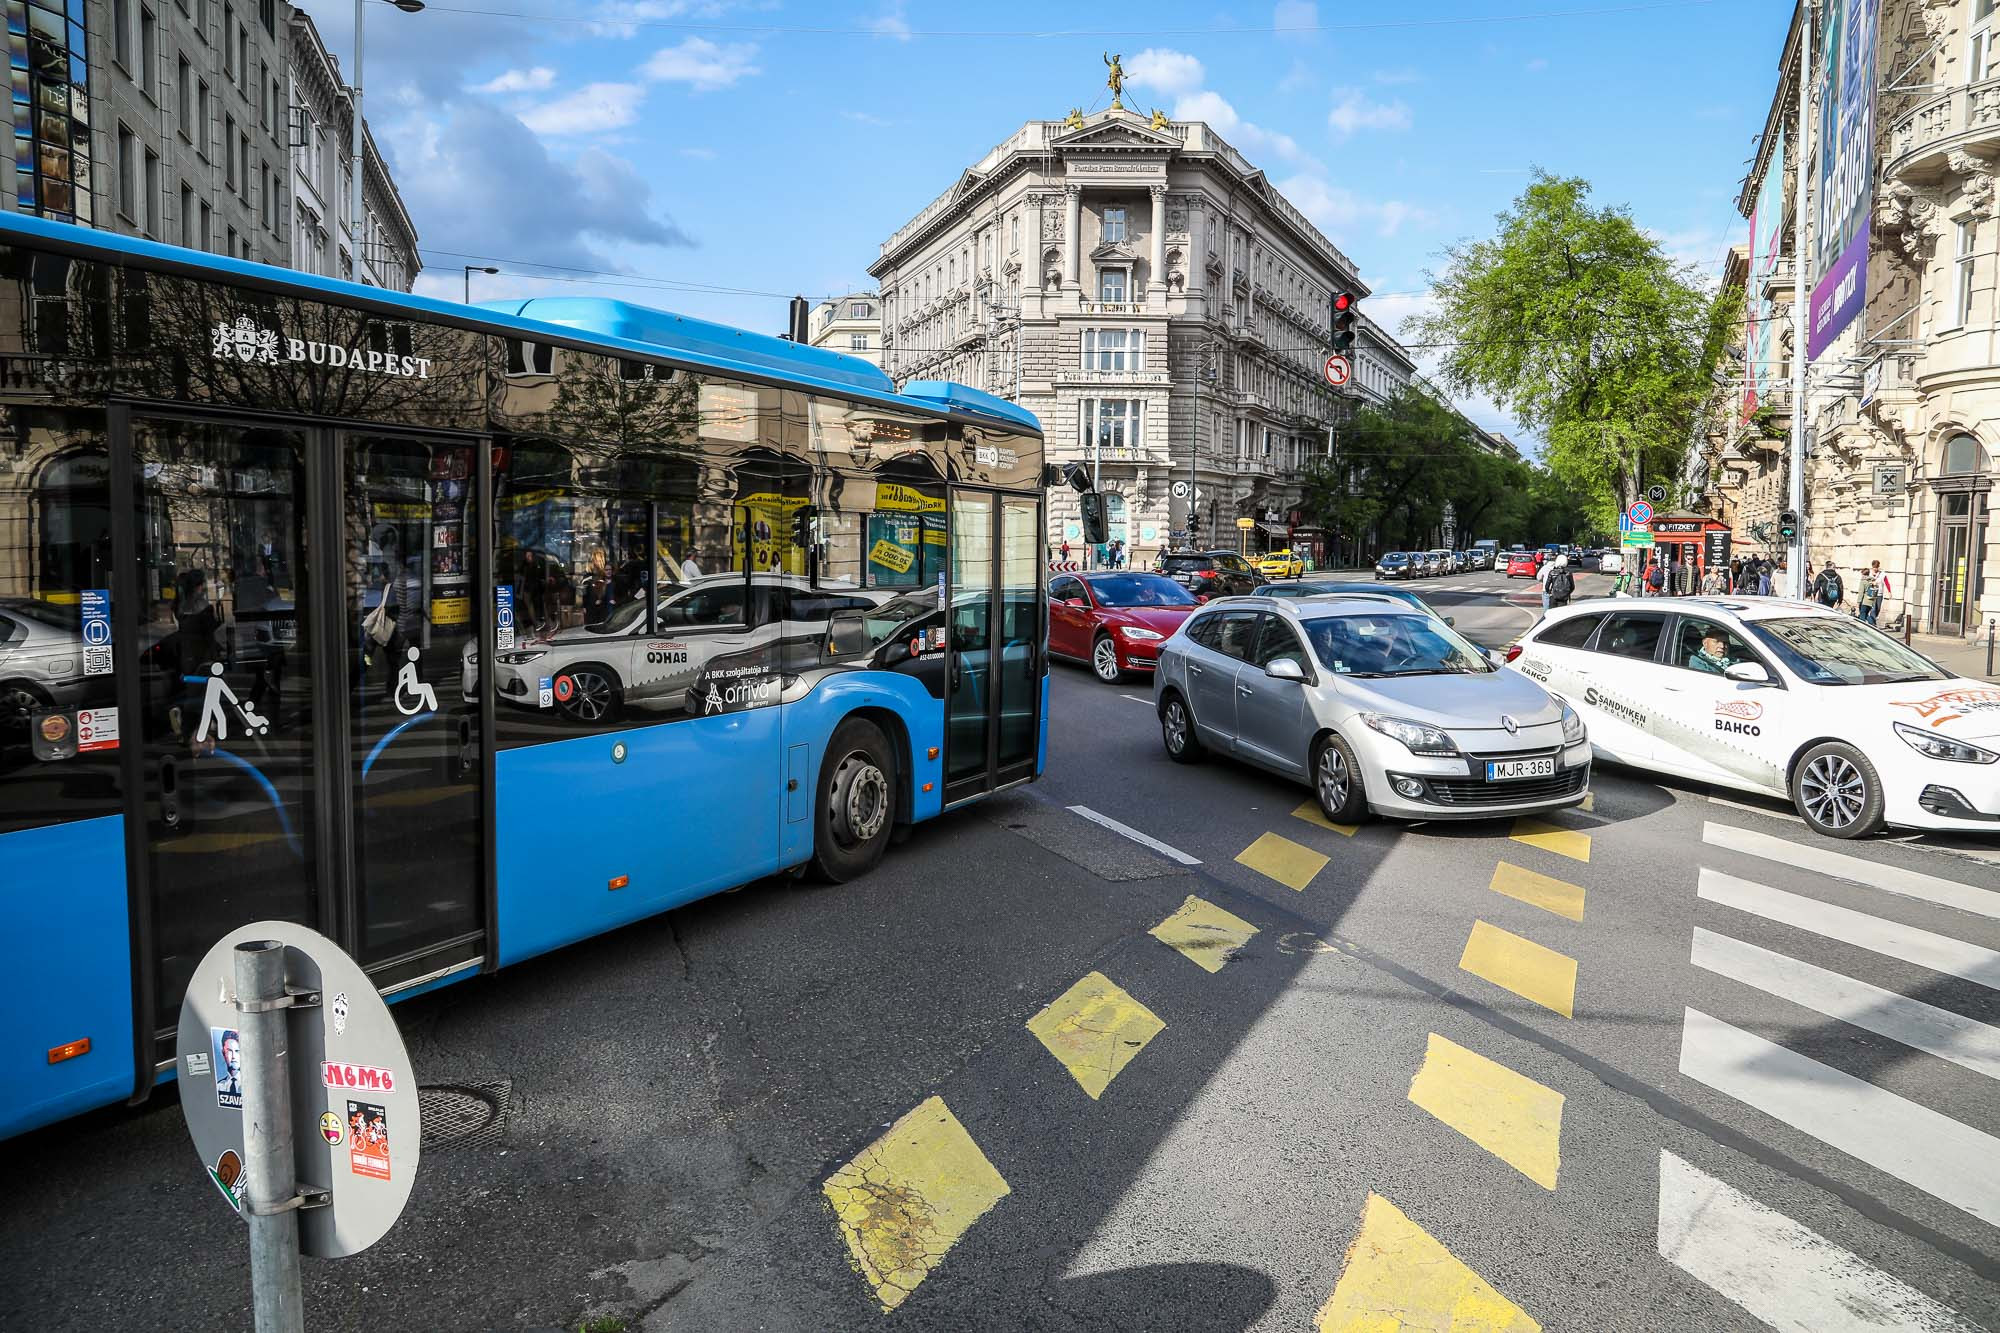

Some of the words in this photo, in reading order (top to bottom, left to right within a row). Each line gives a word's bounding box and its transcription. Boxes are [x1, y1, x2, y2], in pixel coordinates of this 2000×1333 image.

[287, 337, 431, 379] BUDAPEST
[704, 671, 711, 680] A
[711, 669, 725, 679] BKK
[725, 665, 761, 678] szolgáltatója
[762, 665, 769, 673] az
[1521, 666, 1548, 682] BAHCO
[725, 680, 769, 704] arriva
[1598, 694, 1646, 723] SANDVIKEN
[1715, 719, 1761, 737] BAHCO
[1497, 760, 1552, 777] MJR-369
